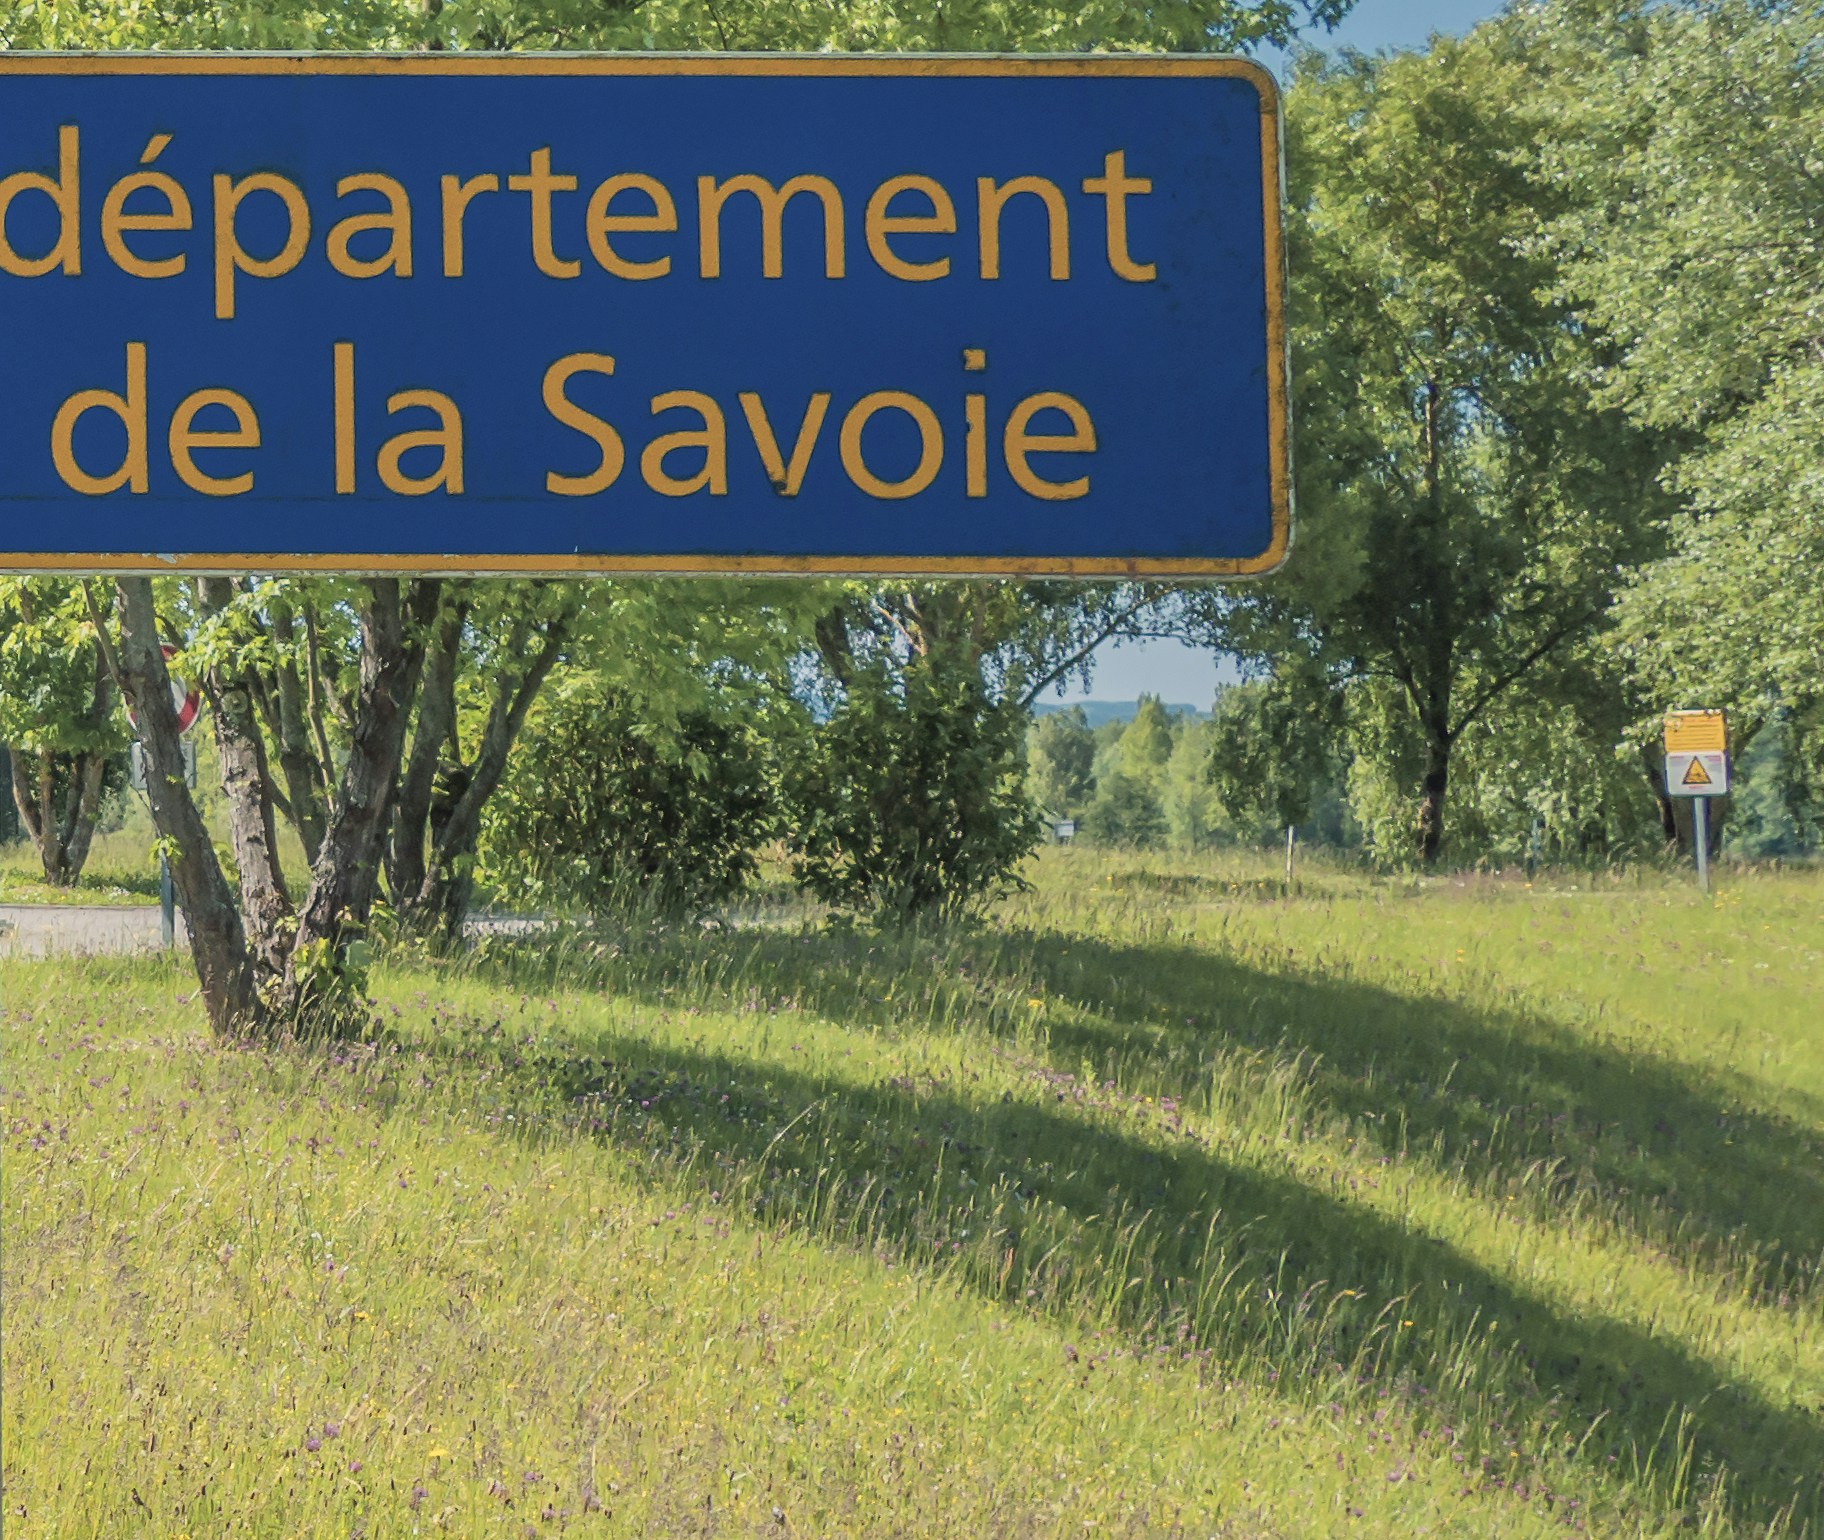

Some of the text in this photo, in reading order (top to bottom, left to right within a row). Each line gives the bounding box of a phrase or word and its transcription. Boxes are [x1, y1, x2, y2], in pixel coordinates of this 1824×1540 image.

[51, 341, 1097, 500] de la Savoie
